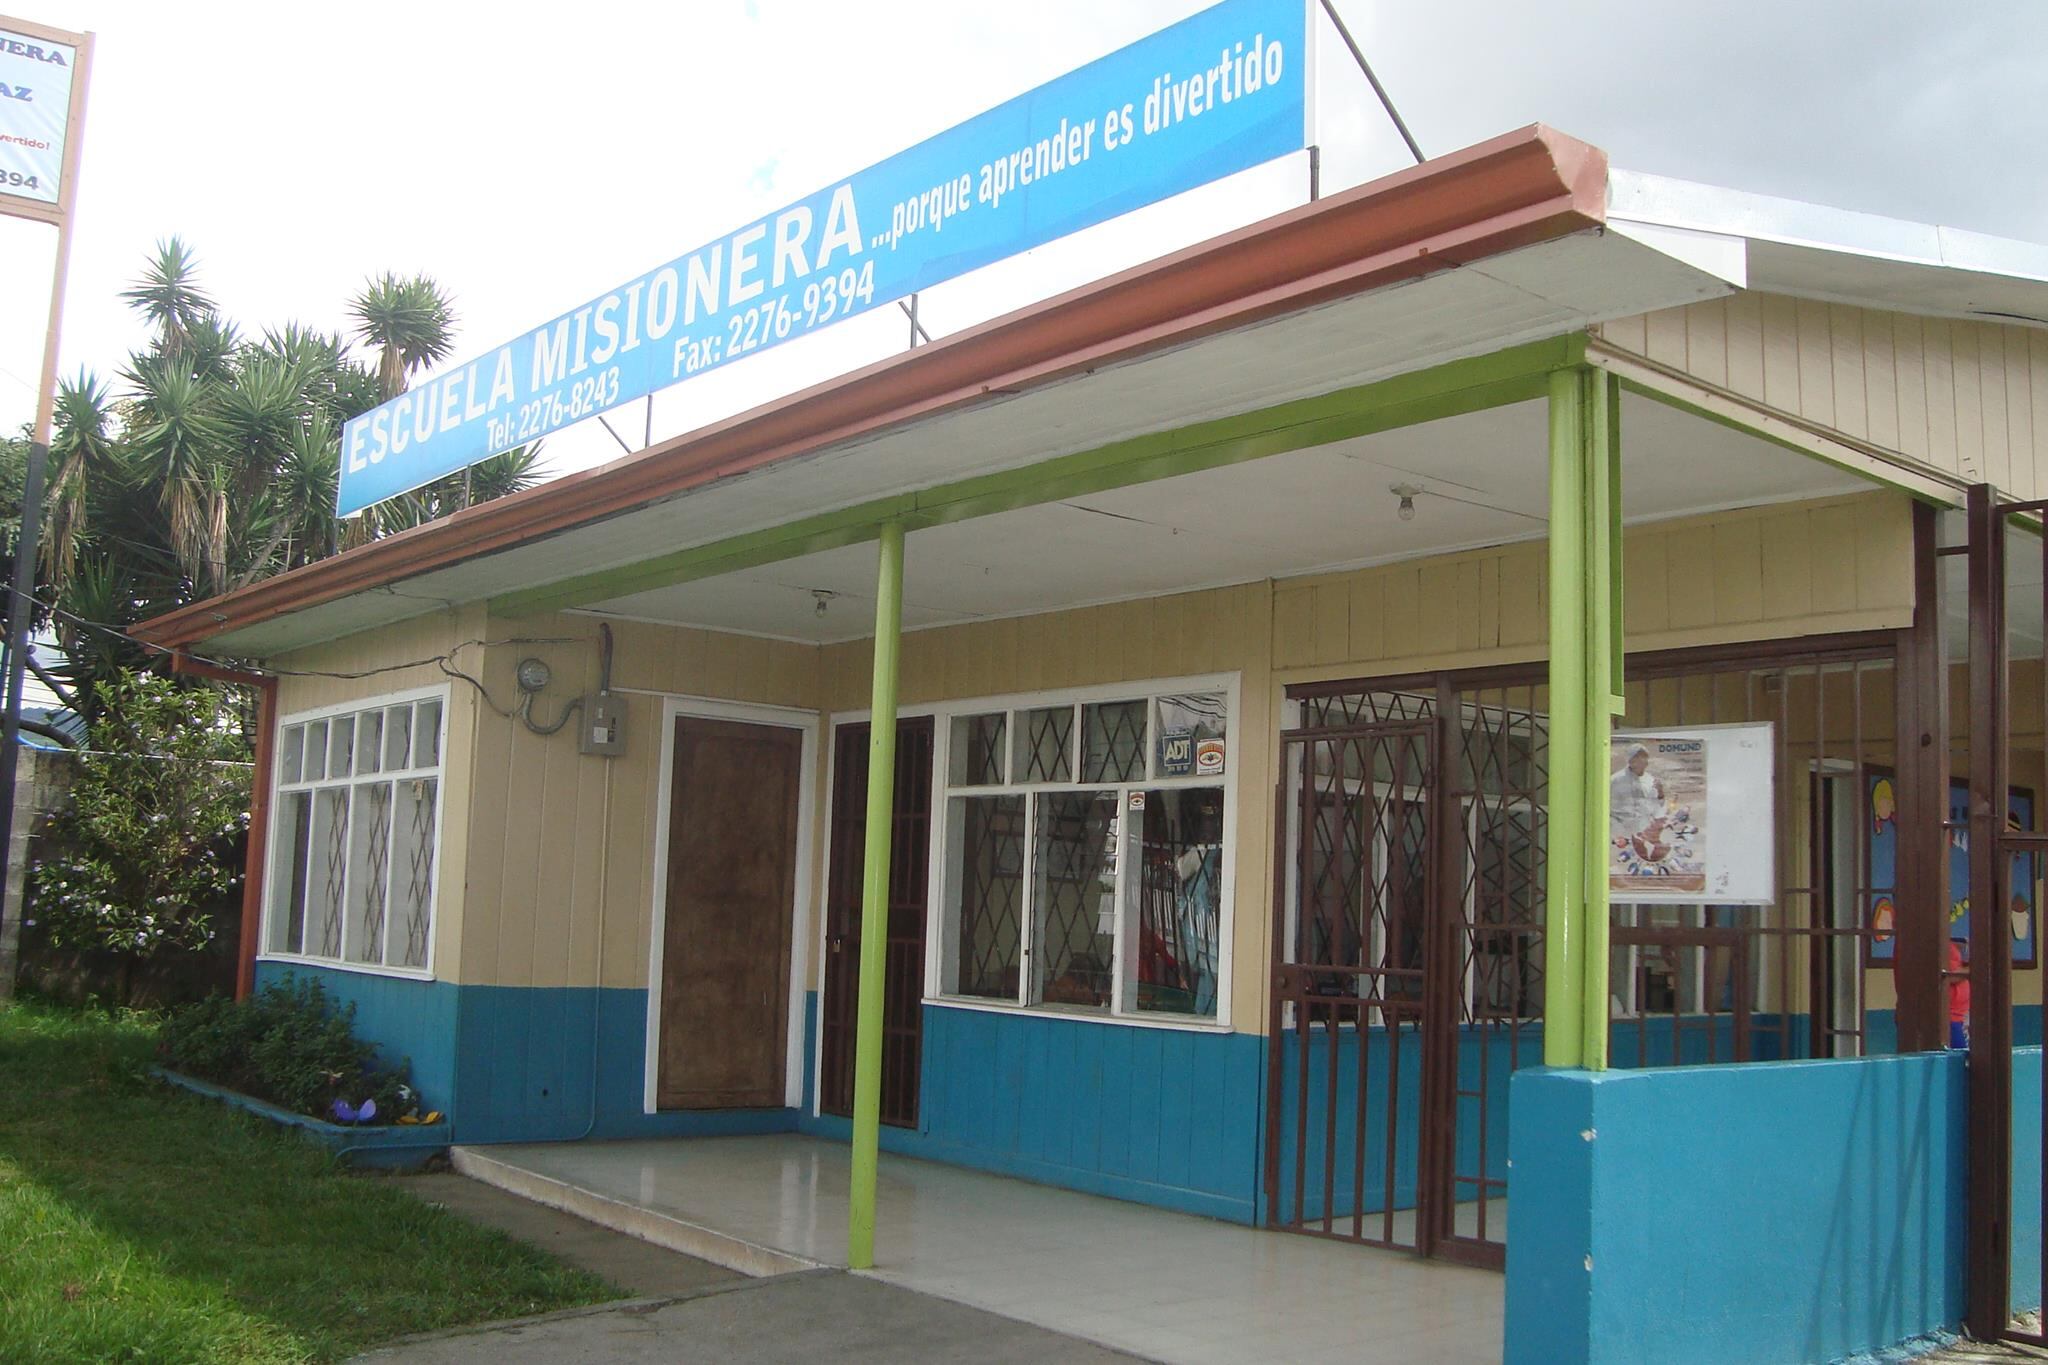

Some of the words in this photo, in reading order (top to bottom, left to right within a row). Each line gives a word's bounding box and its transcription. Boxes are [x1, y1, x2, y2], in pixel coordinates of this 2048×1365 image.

[872, 178, 970, 250] ...porque
[979, 118, 1095, 208] aprender
[1104, 102, 1133, 152] es
[1144, 33, 1282, 136] divertido
[349, 373, 514, 473] ESCUELA
[532, 183, 862, 393] MISIONERA
[673, 336, 721, 377] Fax:
[727, 261, 874, 359] 2276-9394
[487, 419, 514, 452] Tel:
[518, 366, 619, 440] 2276-8243
[1165, 740, 1190, 760] ADT
[1659, 743, 1701, 752] DOMUND
